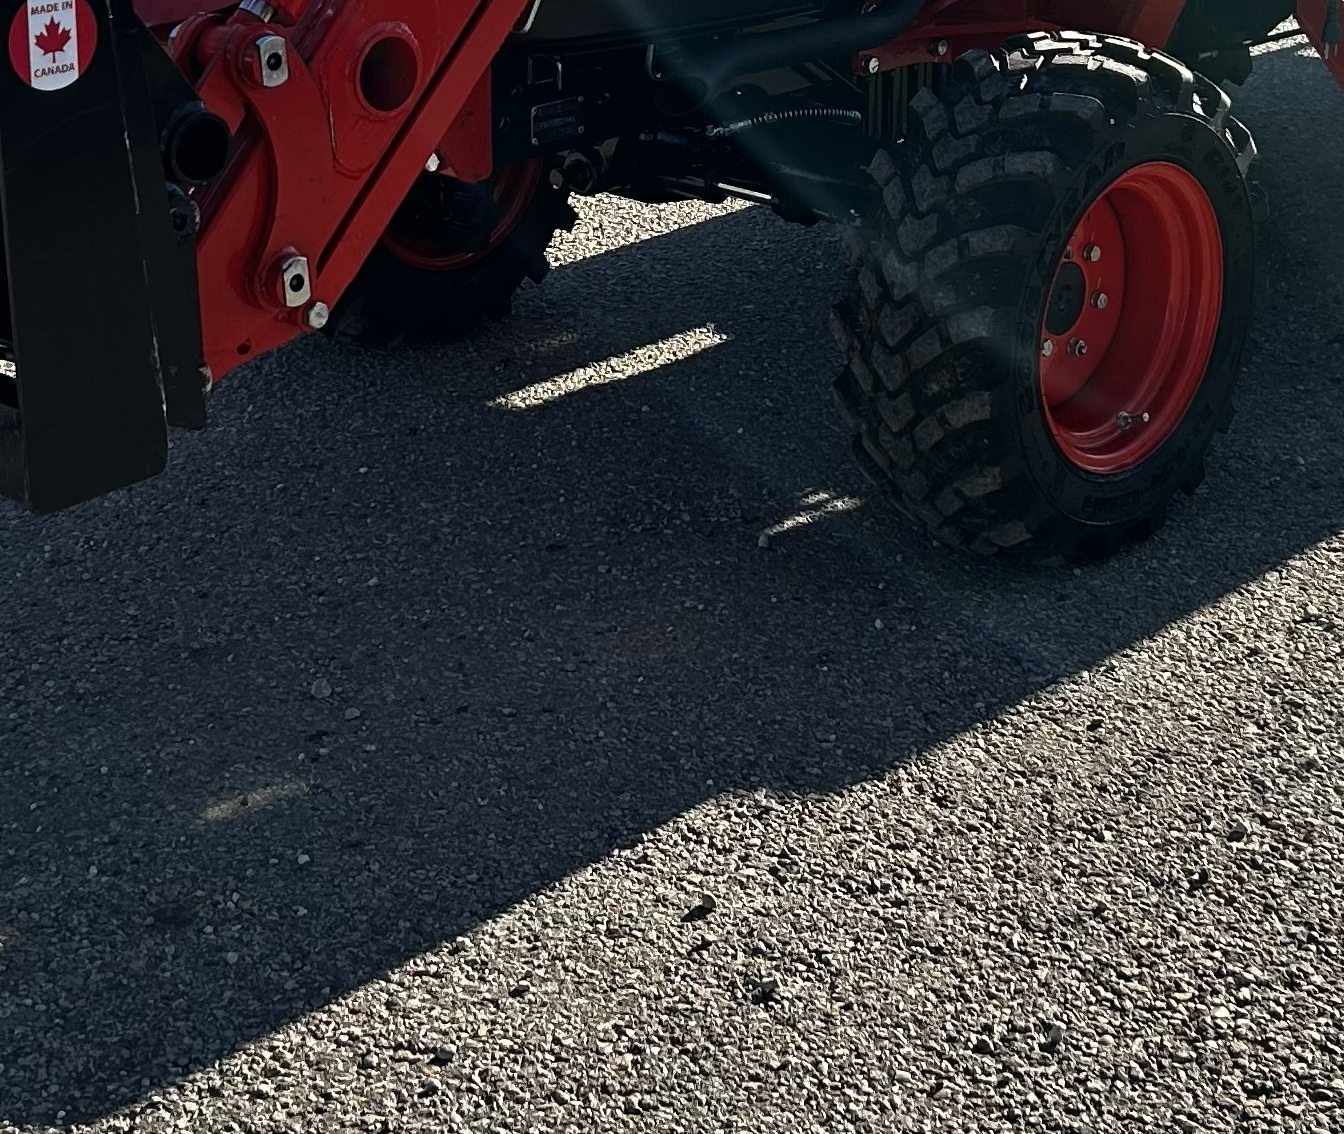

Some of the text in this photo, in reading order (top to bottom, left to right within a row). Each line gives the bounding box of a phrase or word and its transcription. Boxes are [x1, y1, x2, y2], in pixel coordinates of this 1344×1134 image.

[30, 0, 73, 15] MADE IN
[34, 63, 76, 78] CANADA
